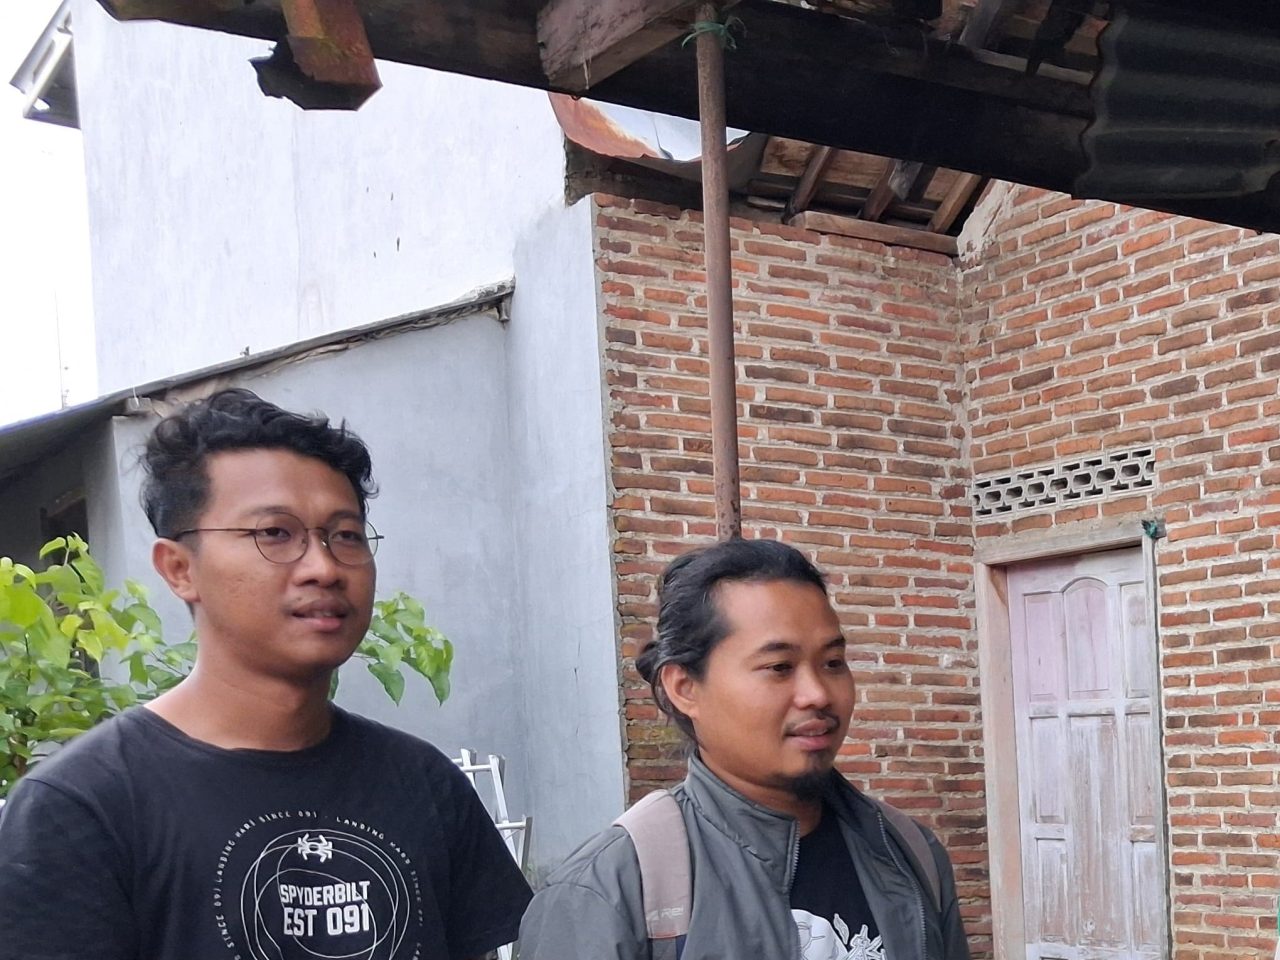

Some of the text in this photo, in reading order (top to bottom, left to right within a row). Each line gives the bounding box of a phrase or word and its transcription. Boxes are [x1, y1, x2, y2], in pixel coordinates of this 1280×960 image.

[336, 816, 385, 840] LANDING
[280, 881, 371, 906] SPYDERBILT
[283, 902, 370, 937] EST 091
